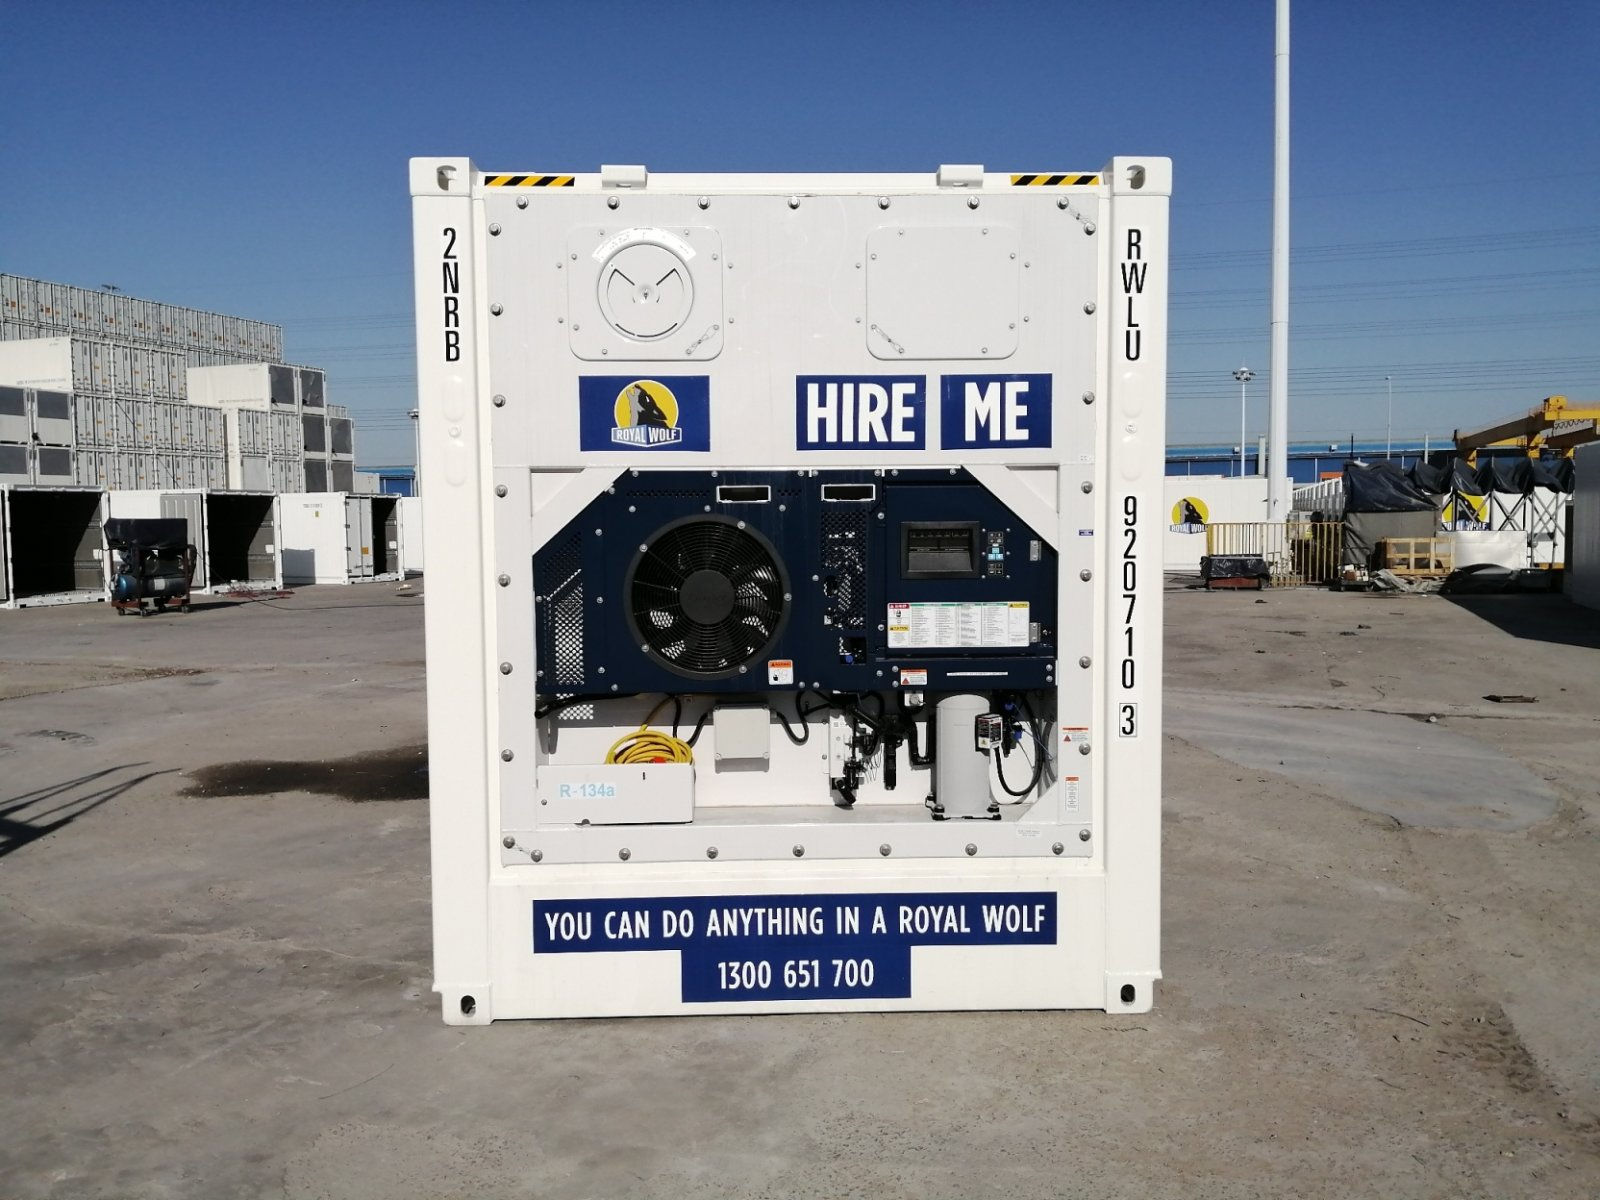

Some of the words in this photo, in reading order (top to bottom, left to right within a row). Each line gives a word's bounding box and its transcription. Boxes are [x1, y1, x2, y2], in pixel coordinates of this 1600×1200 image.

[443, 227, 460, 362] 2NRB
[1121, 228, 1148, 361] RWLU
[807, 382, 916, 443] HIRE
[964, 381, 1030, 442] ME
[616, 426, 646, 443] ROYAL
[648, 426, 677, 443] WOLF
[1121, 495, 1138, 689] 920710
[1121, 704, 1135, 735] 3
[560, 783, 615, 798] R-134a
[544, 912, 592, 941] YOU
[604, 910, 650, 940] CAN
[662, 909, 695, 939] DO
[706, 907, 824, 937] ANYTHING
[837, 906, 860, 935] IN
[871, 906, 887, 934] A
[899, 905, 971, 934] ROYAL
[982, 904, 1046, 933] WOLF
[717, 960, 772, 990] 1300
[783, 959, 820, 988] 651
[831, 958, 875, 987] 700
